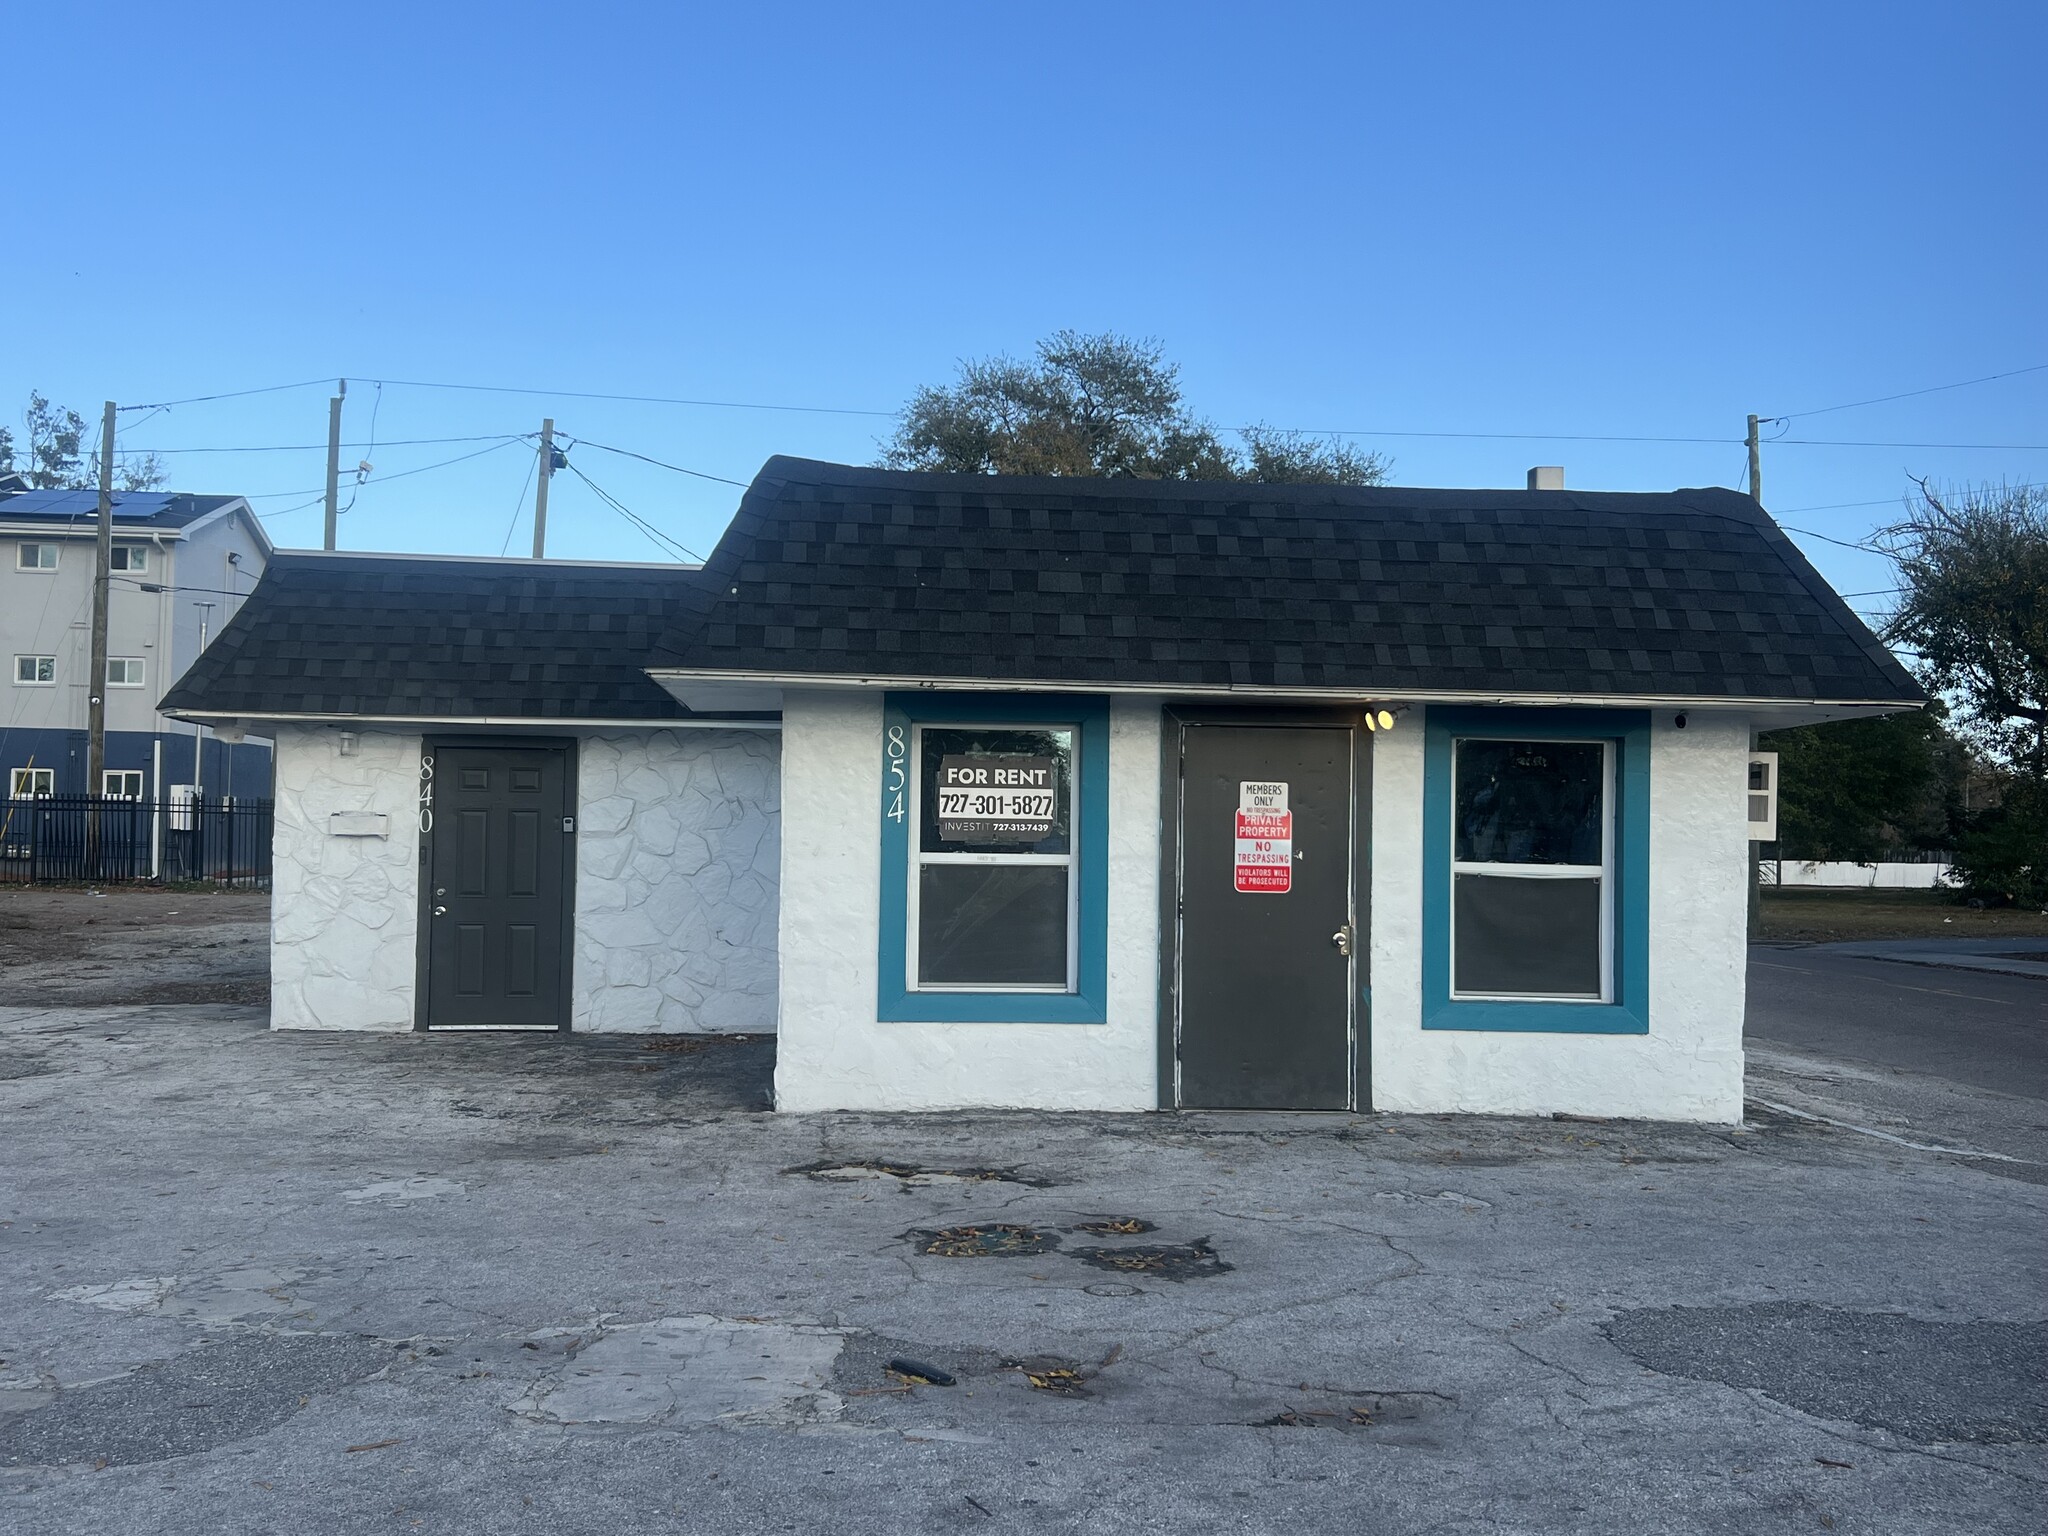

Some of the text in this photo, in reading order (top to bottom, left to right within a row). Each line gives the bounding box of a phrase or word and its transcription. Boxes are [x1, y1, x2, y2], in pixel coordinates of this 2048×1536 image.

[887, 725, 905, 824] 854
[947, 768, 1047, 786] FOR RENT
[419, 756, 434, 833] 840
[1246, 785, 1282, 795] MEMBERS
[940, 793, 1053, 817] 727-301-5827
[1254, 796, 1273, 806] ONLY
[1245, 816, 1282, 826] PRIVATE
[993, 823, 1049, 832] 727-313-7439
[1240, 827, 1287, 837] PROPERTY
[1256, 842, 1271, 851] NO
[1238, 854, 1288, 863] TRESPASSING
[1249, 877, 1288, 885] PROSECUTED
